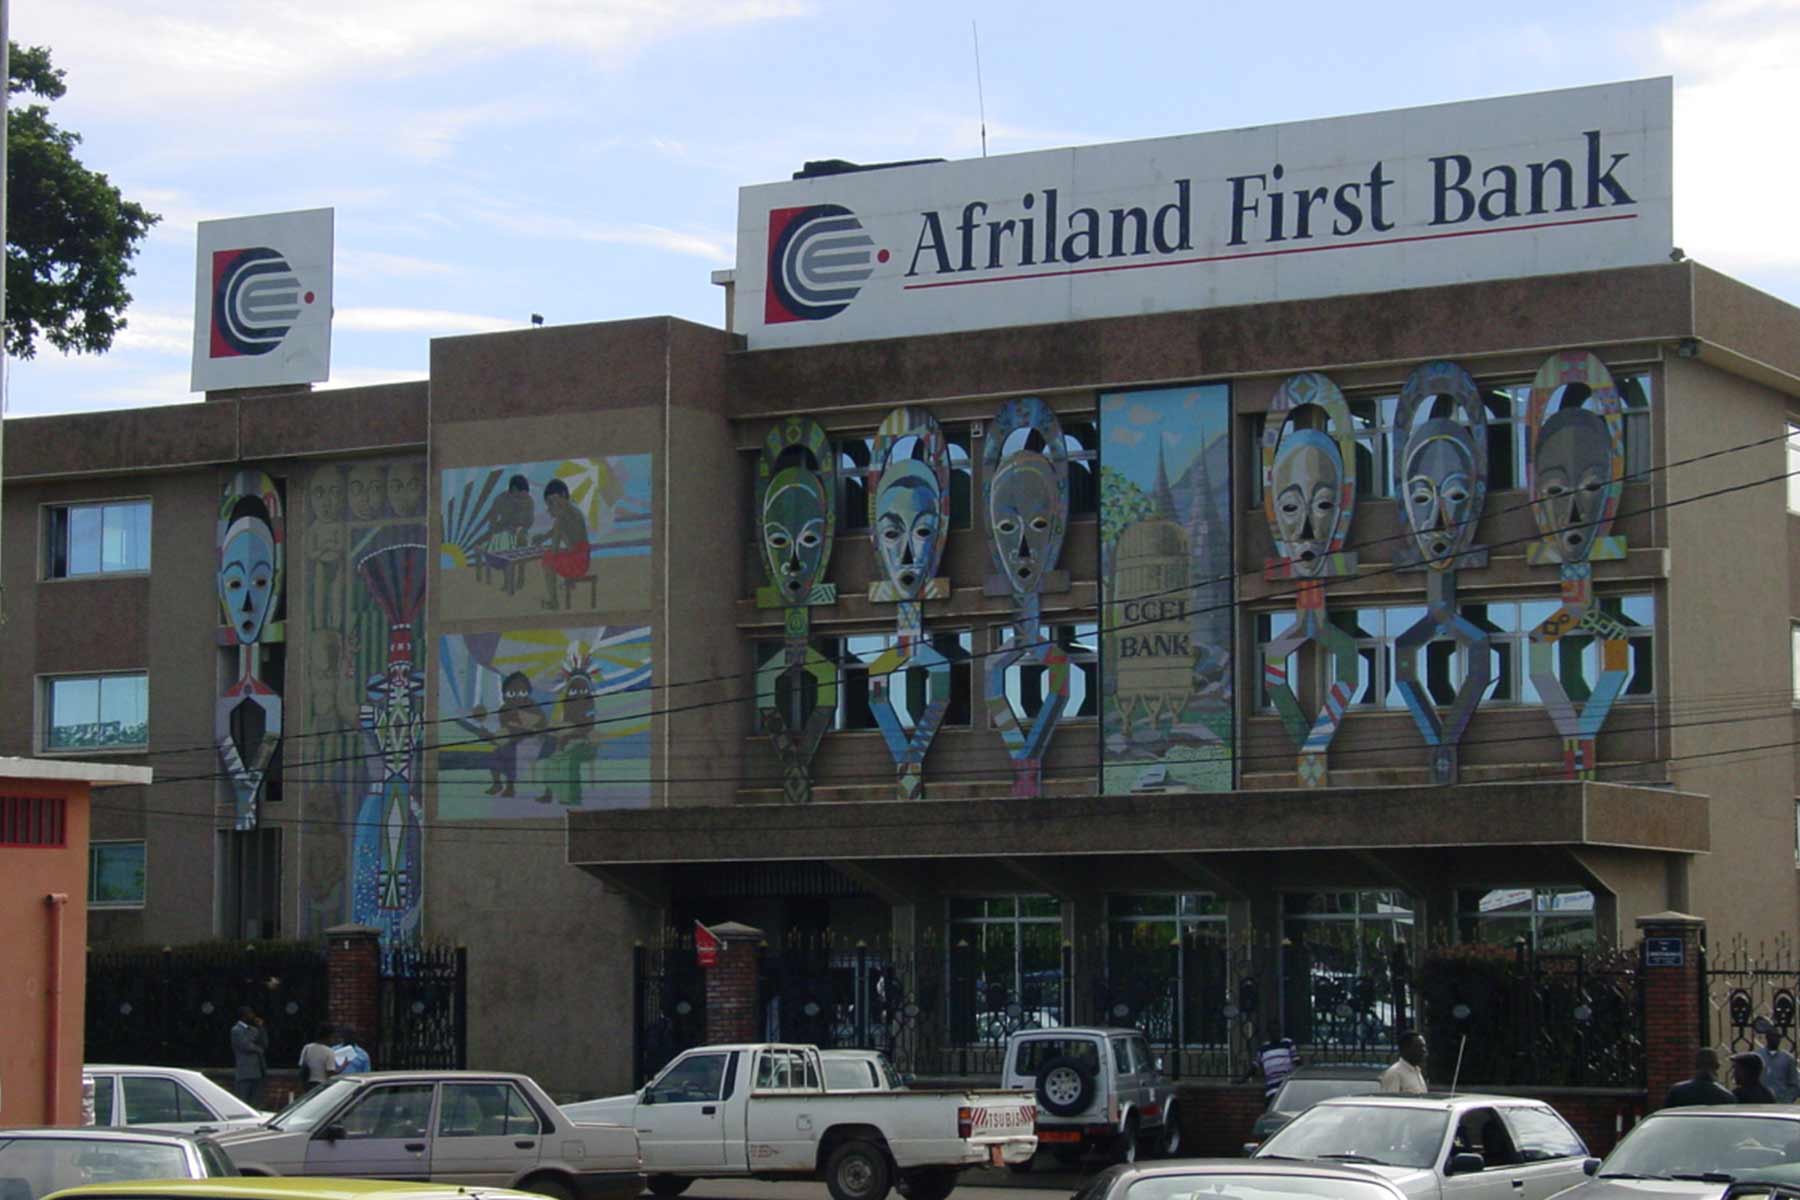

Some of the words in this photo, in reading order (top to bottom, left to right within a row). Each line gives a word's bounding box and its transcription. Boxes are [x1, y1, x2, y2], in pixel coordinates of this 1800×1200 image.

[904, 179, 1194, 278] Afriland
[1226, 161, 1396, 247] First
[1426, 130, 1638, 227] Bank
[1124, 601, 1186, 622] CCEI
[1120, 634, 1189, 657] BANK
